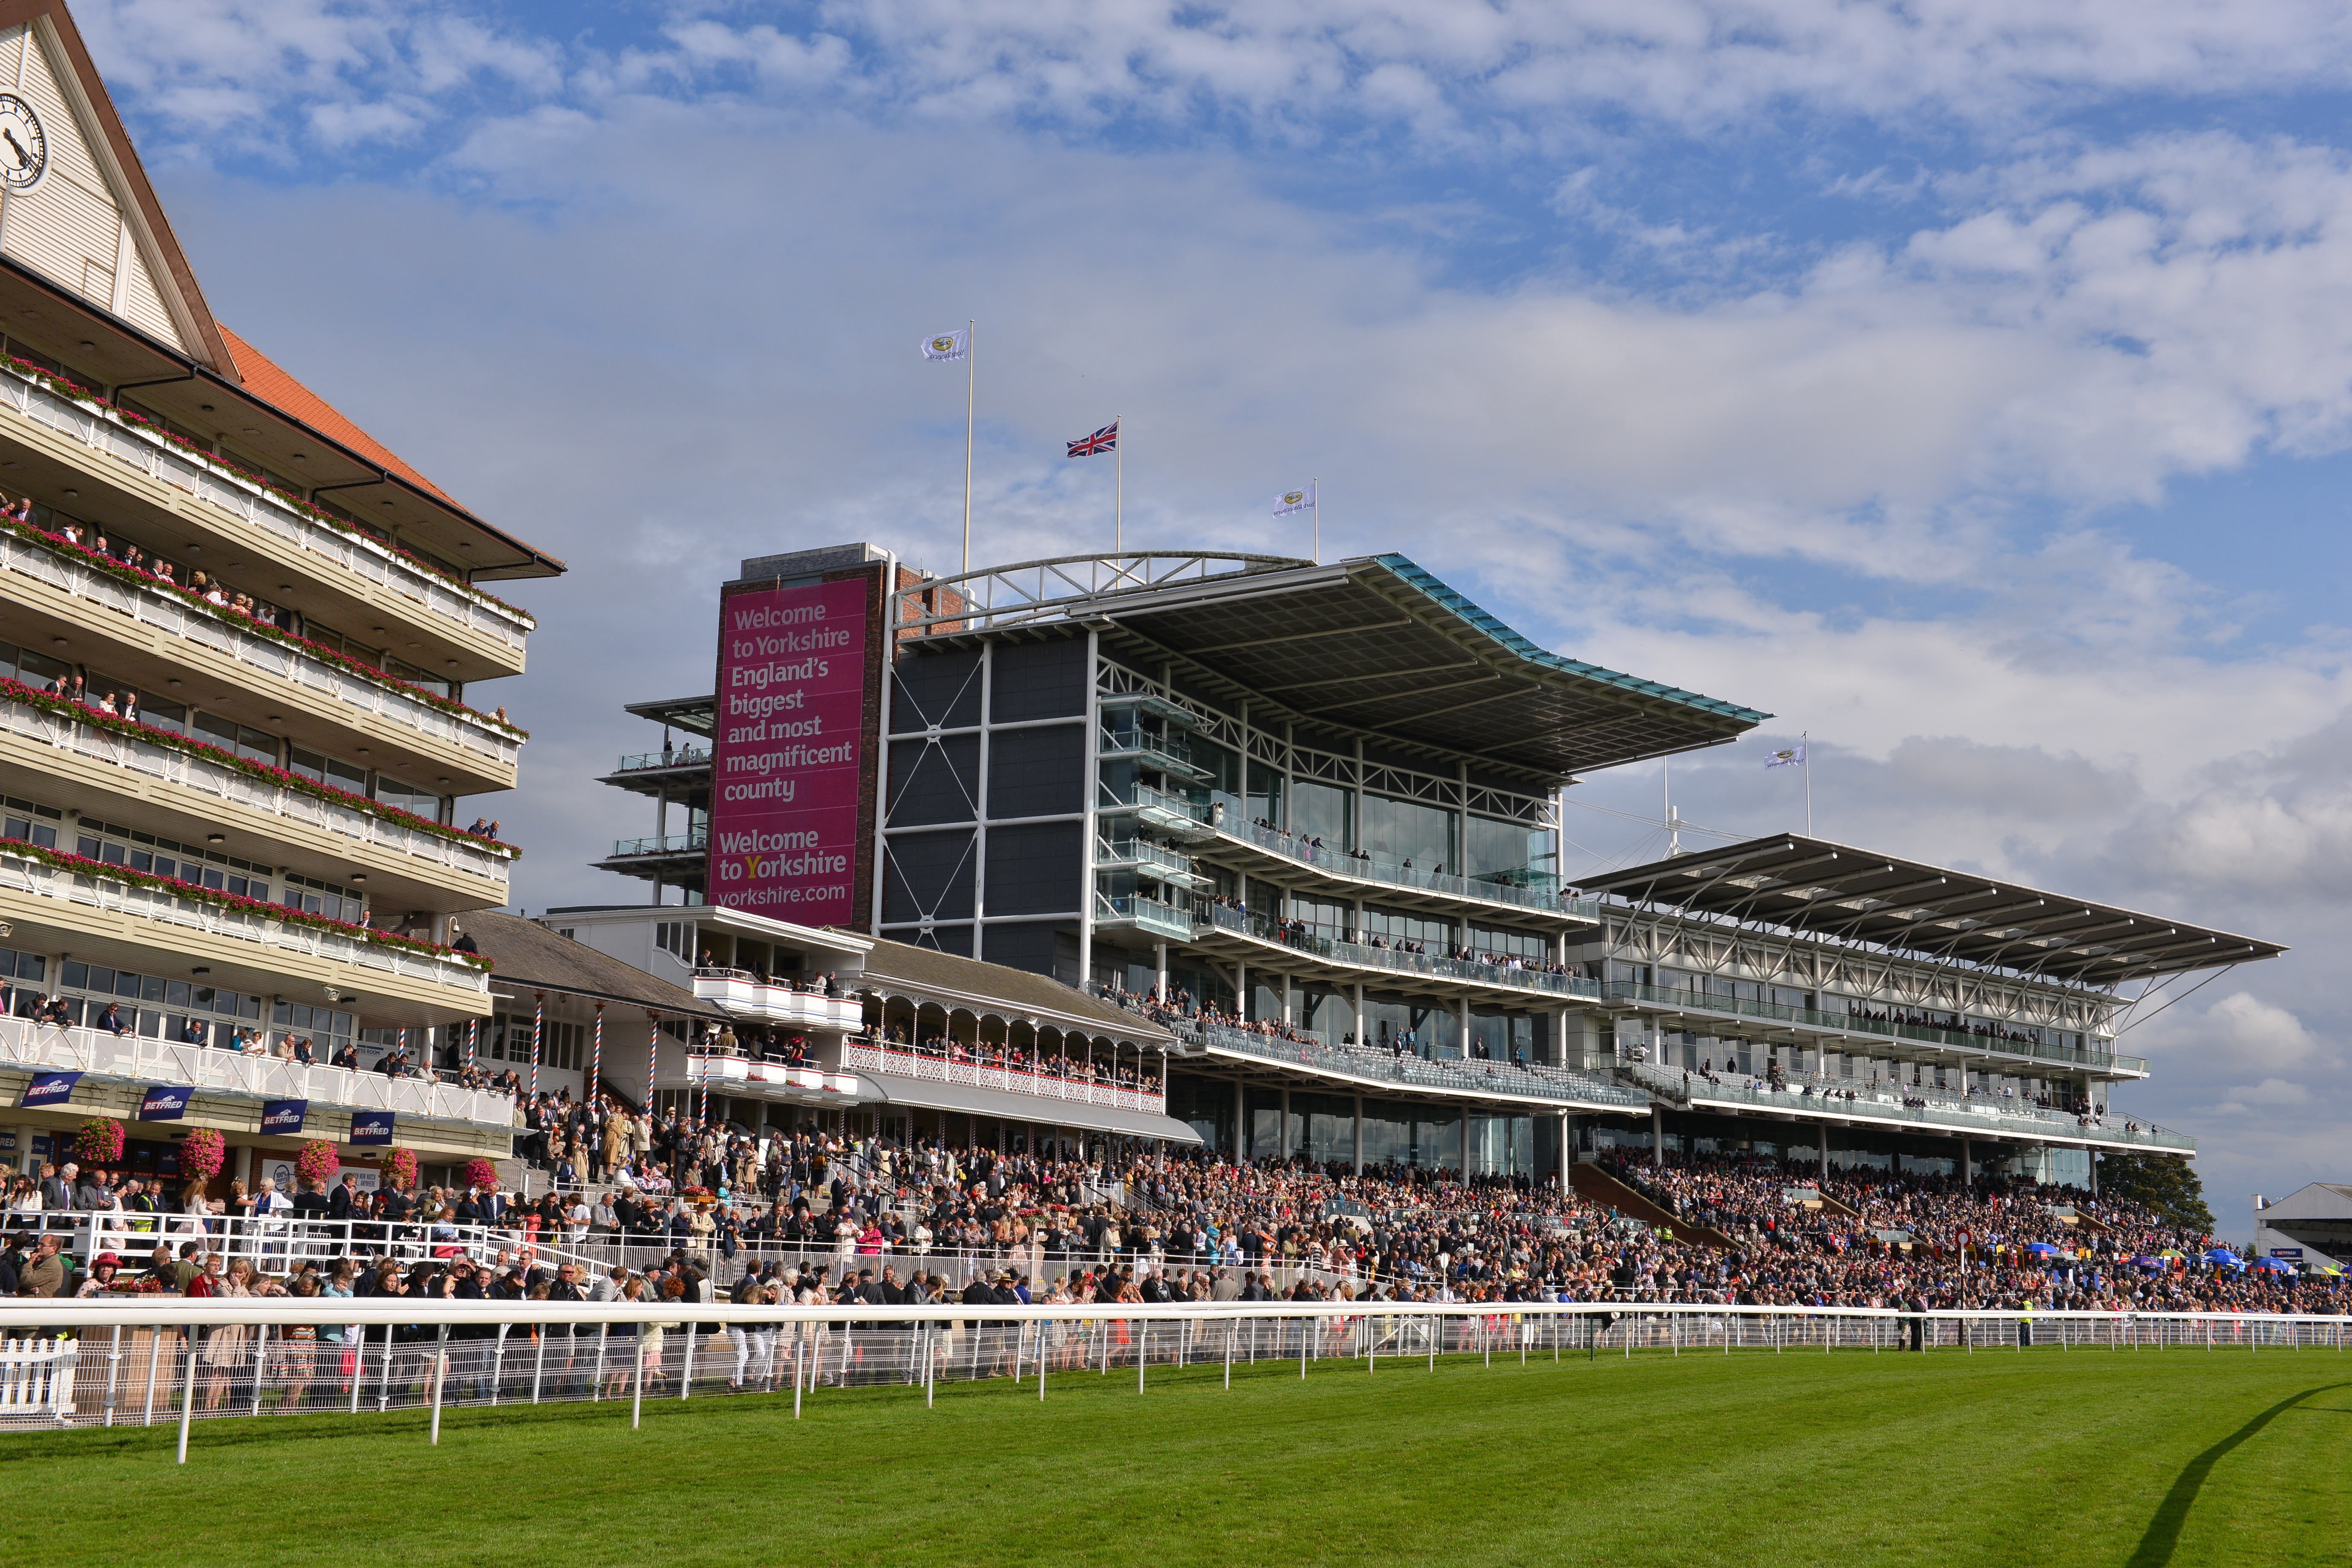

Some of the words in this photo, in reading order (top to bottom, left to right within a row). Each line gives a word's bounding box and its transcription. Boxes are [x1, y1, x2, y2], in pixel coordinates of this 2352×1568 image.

[735, 605, 826, 629] Welcome
[733, 640, 754, 658] to
[756, 627, 850, 655] Yorkshire
[732, 657, 828, 690] England's
[730, 689, 804, 719] biggest
[728, 720, 766, 744] and
[770, 715, 822, 739] most
[726, 741, 852, 775] magnificent
[725, 777, 795, 802] county
[719, 829, 819, 853] Welcome
[720, 859, 742, 880] to
[745, 850, 846, 879] Yorkshire
[718, 885, 845, 907] yorkshire.com
[27, 1084, 69, 1096] BETFRED
[143, 1101, 183, 1110] BETFRED
[264, 1115, 300, 1125] BETFRED
[354, 1127, 389, 1135] BETFRED
[276, 1170, 287, 1179] 100%
